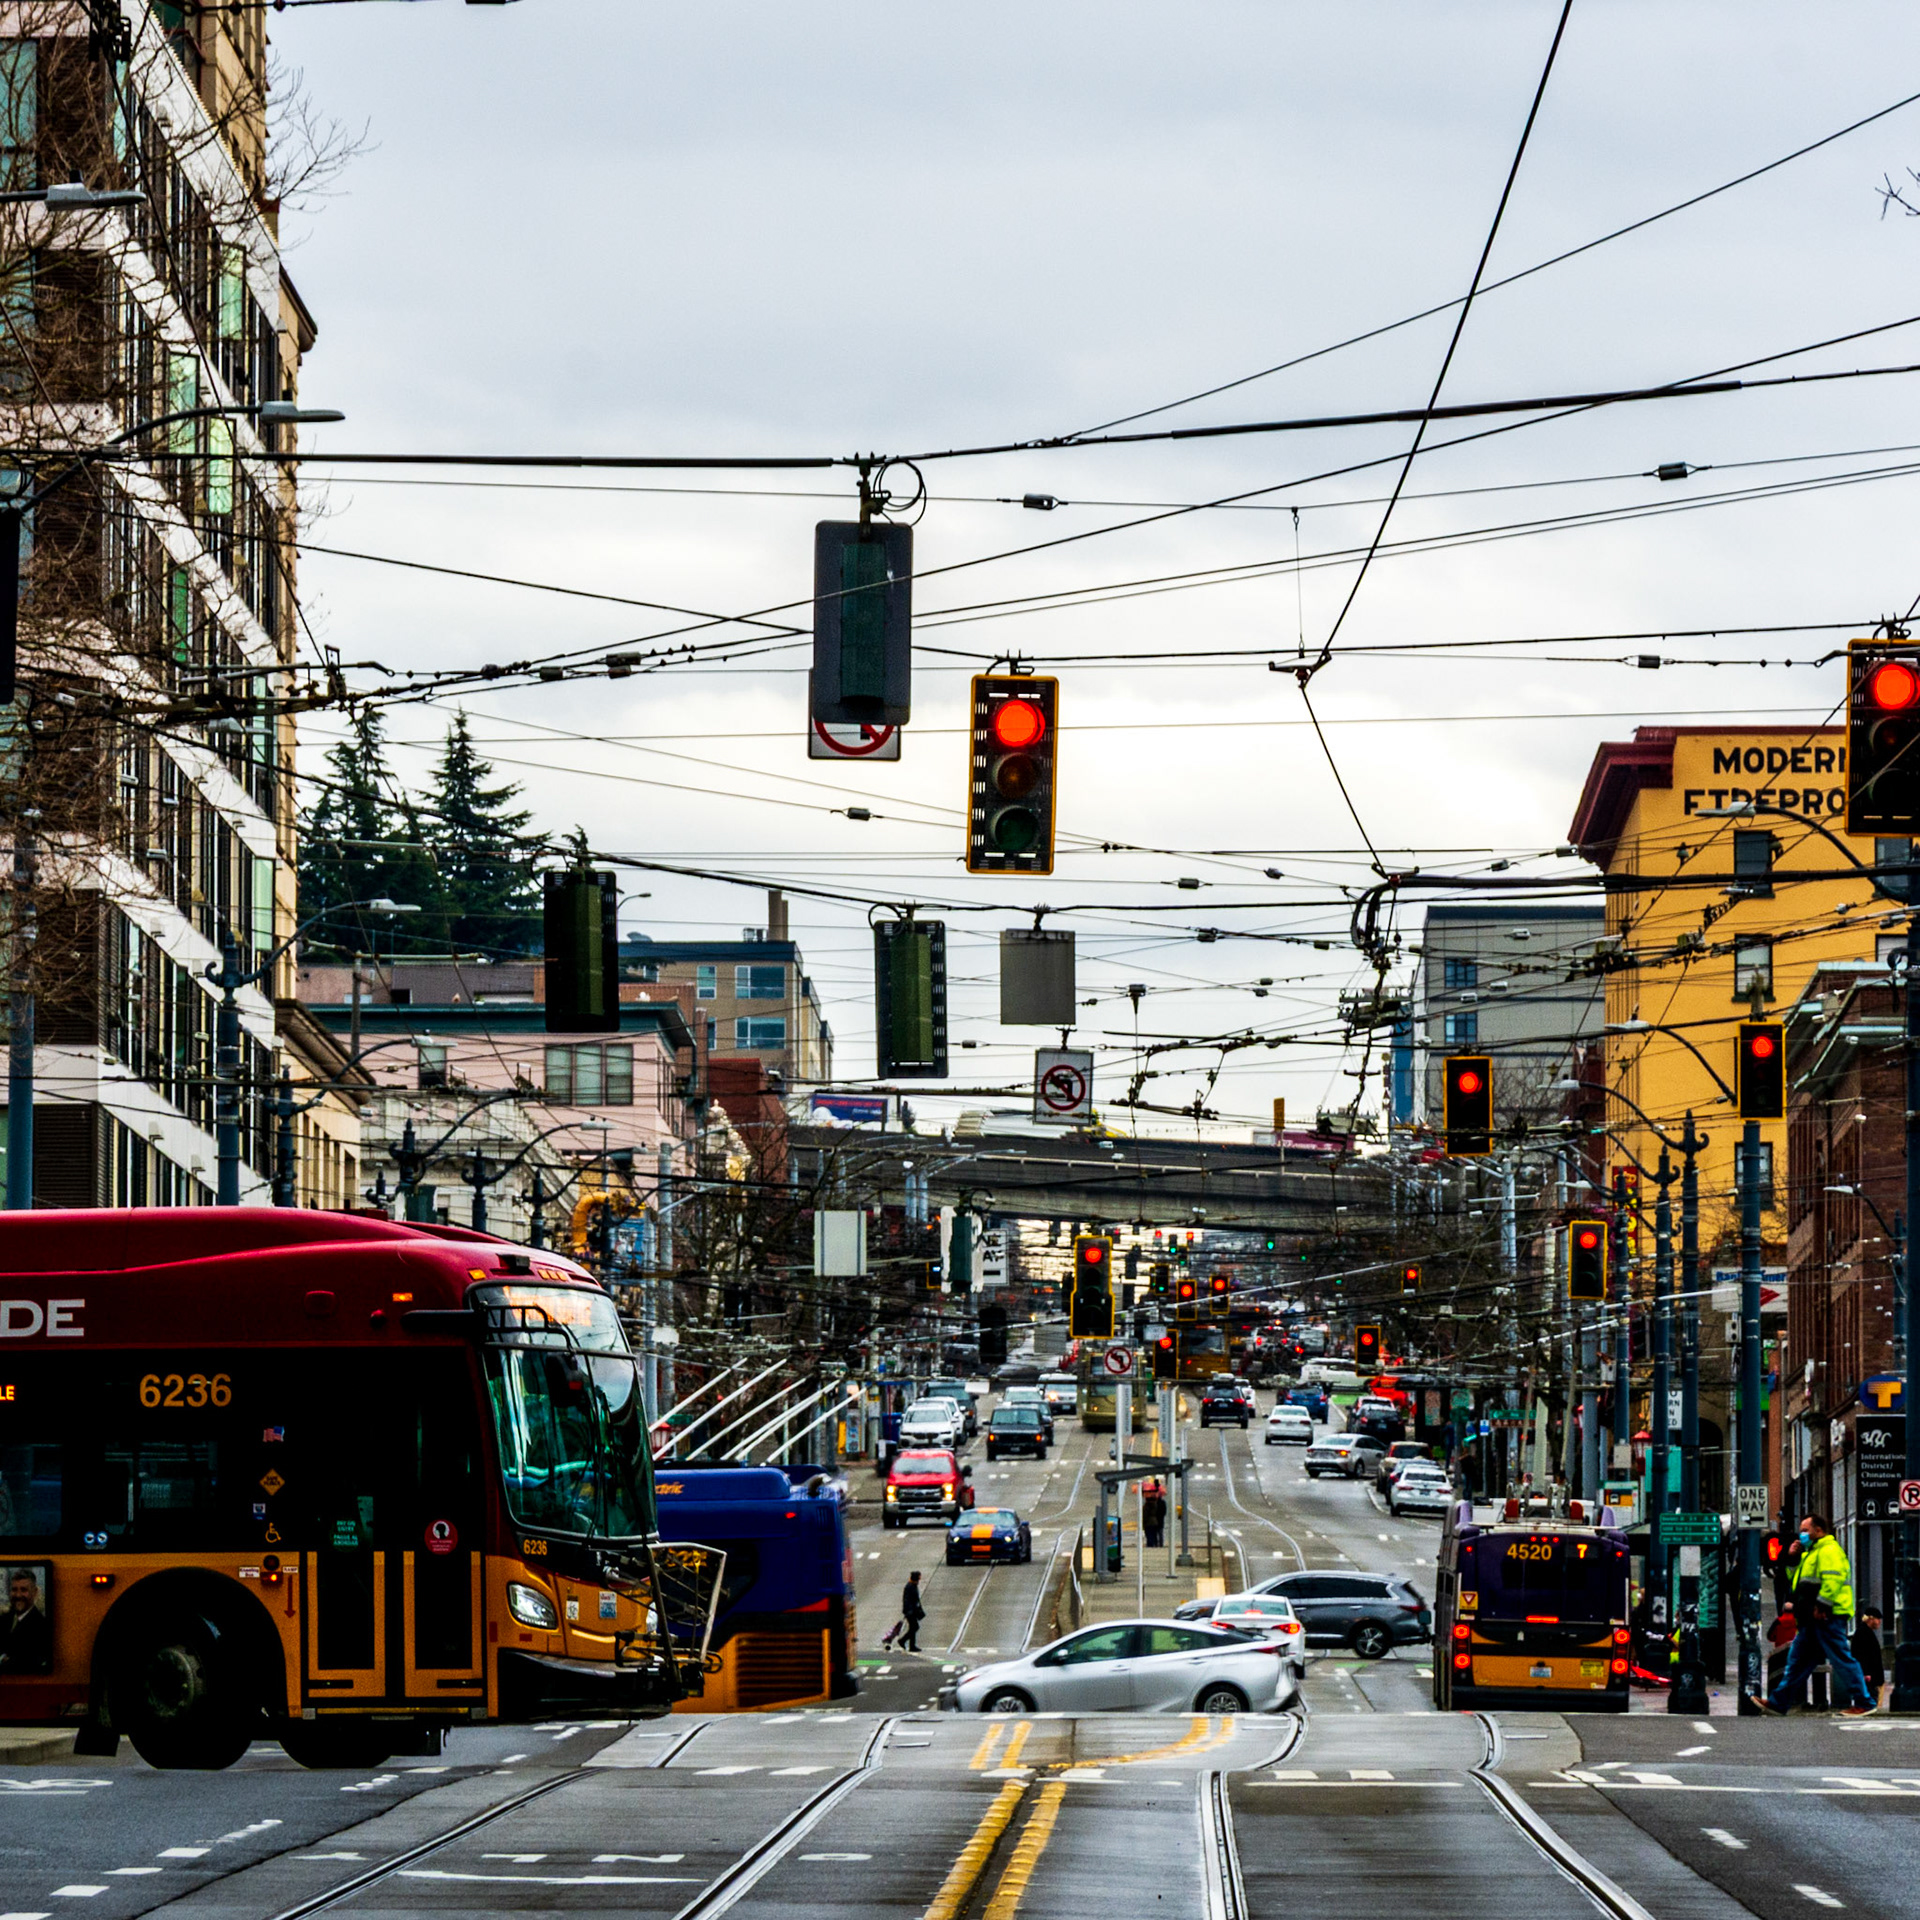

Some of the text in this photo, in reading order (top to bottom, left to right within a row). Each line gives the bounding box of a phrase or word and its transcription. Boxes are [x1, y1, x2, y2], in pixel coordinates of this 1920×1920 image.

[1713, 747, 1846, 774] MODER
[983, 1250, 1005, 1262] AY
[0, 1299, 86, 1338] DE
[140, 1373, 232, 1408] 6236
[1861, 1471, 1902, 1479] Chinatown
[1740, 1488, 1765, 1499] ONE
[1741, 1501, 1766, 1512] WAY
[523, 1539, 548, 1556] 6236
[1507, 1543, 1552, 1560] 4520
[1576, 1543, 1588, 1559] 7
